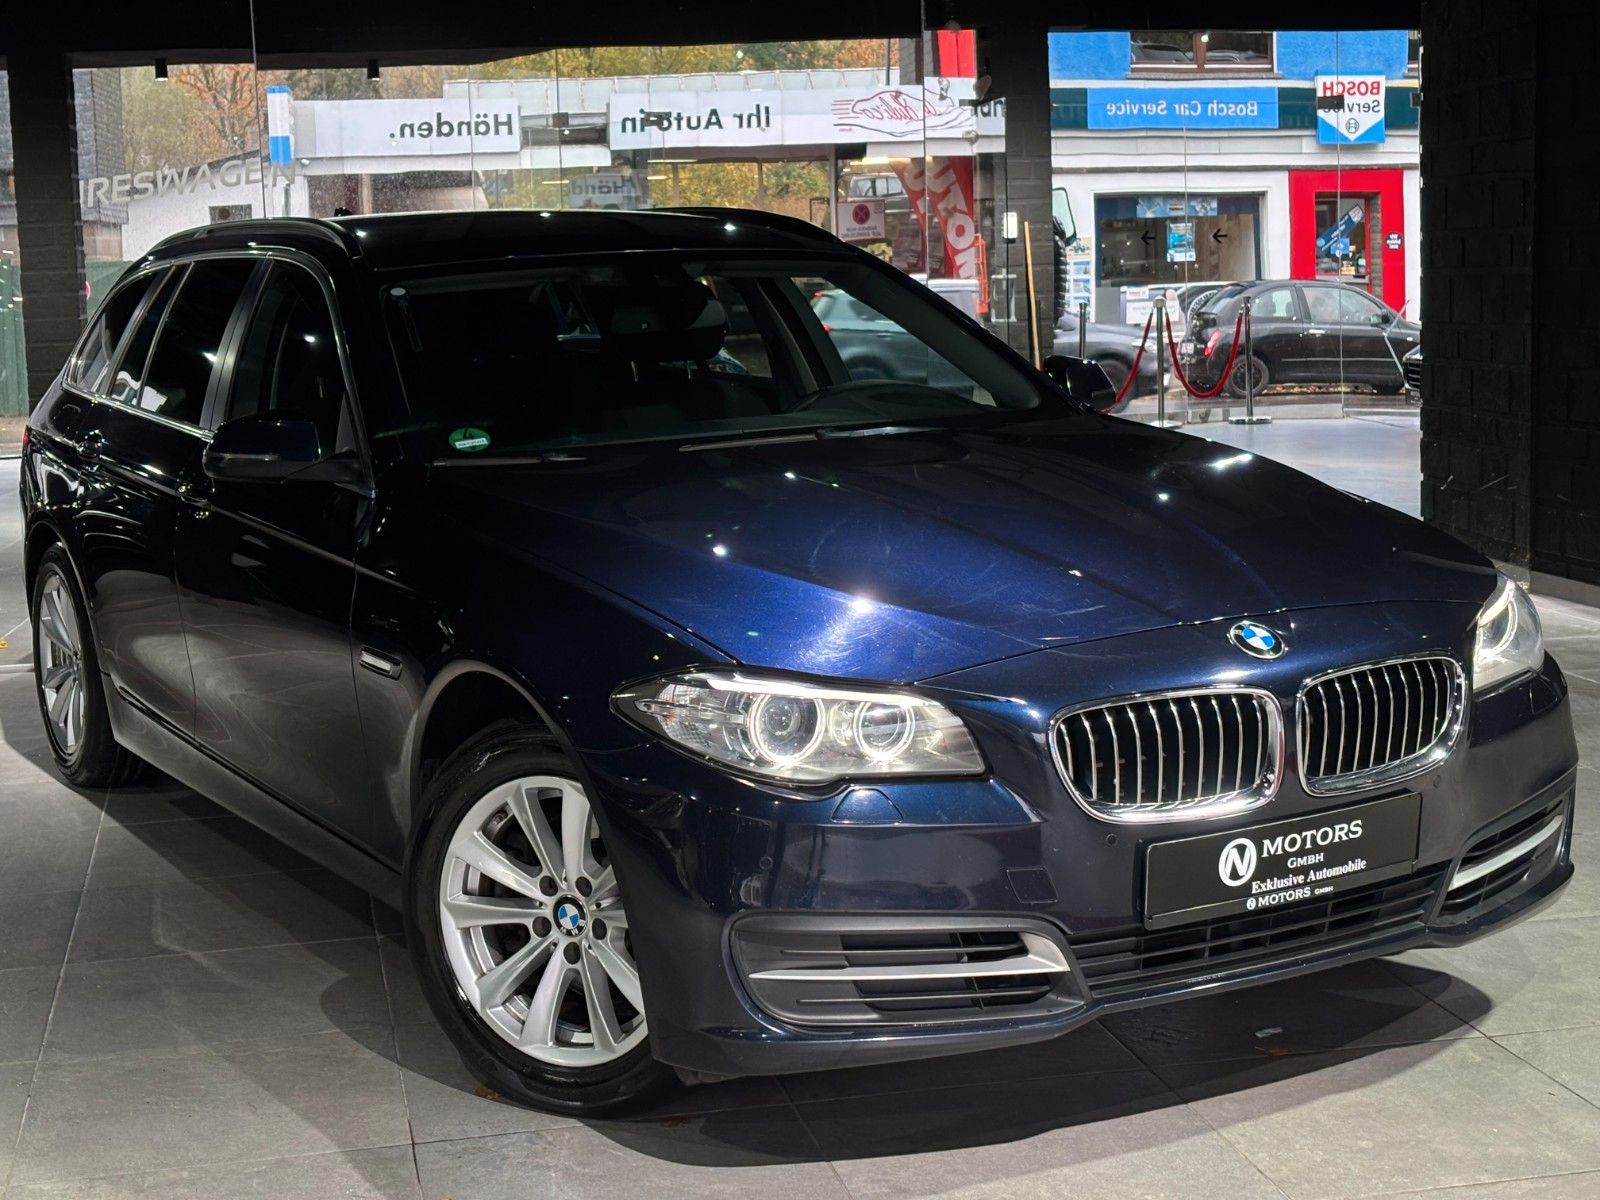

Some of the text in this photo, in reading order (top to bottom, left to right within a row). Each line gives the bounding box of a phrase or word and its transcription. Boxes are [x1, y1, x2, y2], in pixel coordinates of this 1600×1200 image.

[80, 157, 296, 208] RESWAGEN
[1261, 819, 1363, 858] MOTORS
[1251, 858, 1367, 894] Exklusive Automobile
[1287, 852, 1324, 869] GMBH
[1258, 886, 1311, 907] MOTORS
[1314, 885, 1334, 895] GMBH
